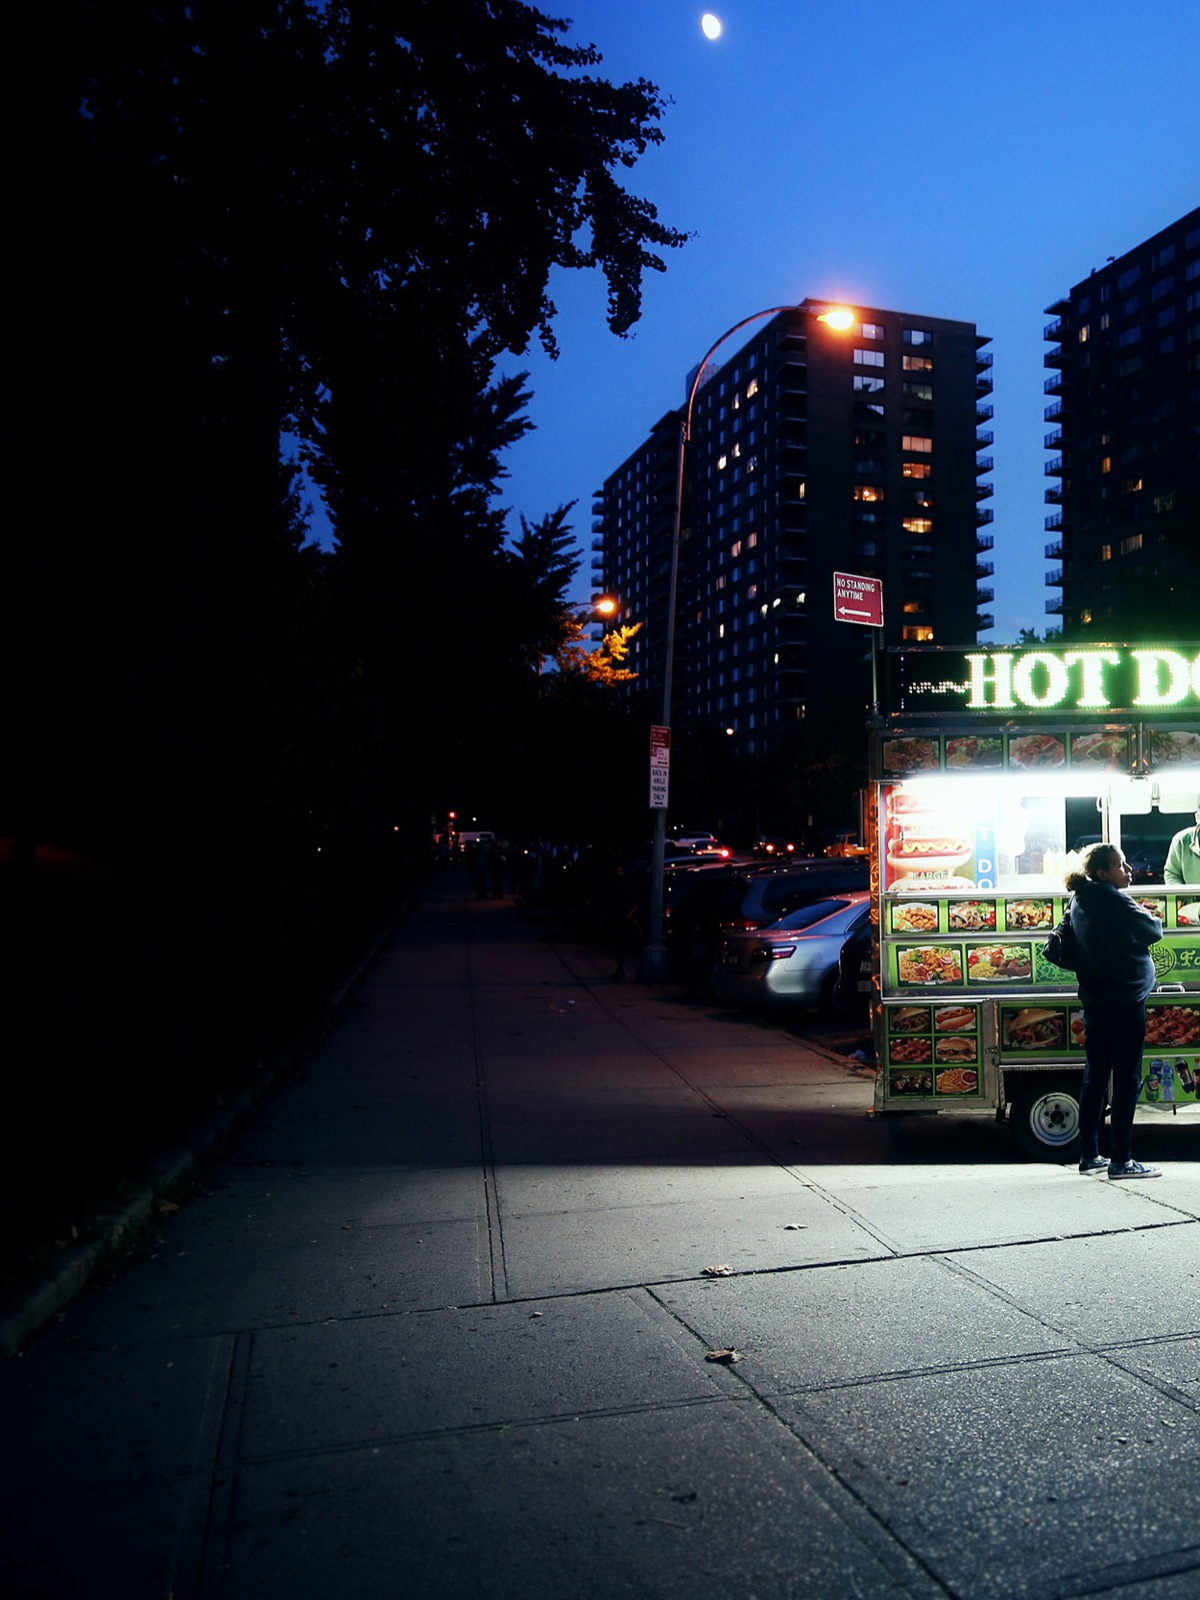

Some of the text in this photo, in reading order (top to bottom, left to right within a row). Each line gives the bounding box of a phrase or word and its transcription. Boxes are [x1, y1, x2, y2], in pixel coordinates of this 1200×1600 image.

[836, 577, 875, 593] NO STANDING
[837, 588, 864, 602] ANYTIME
[964, 651, 1121, 709] HOT
[912, 870, 949, 881] LARGE
